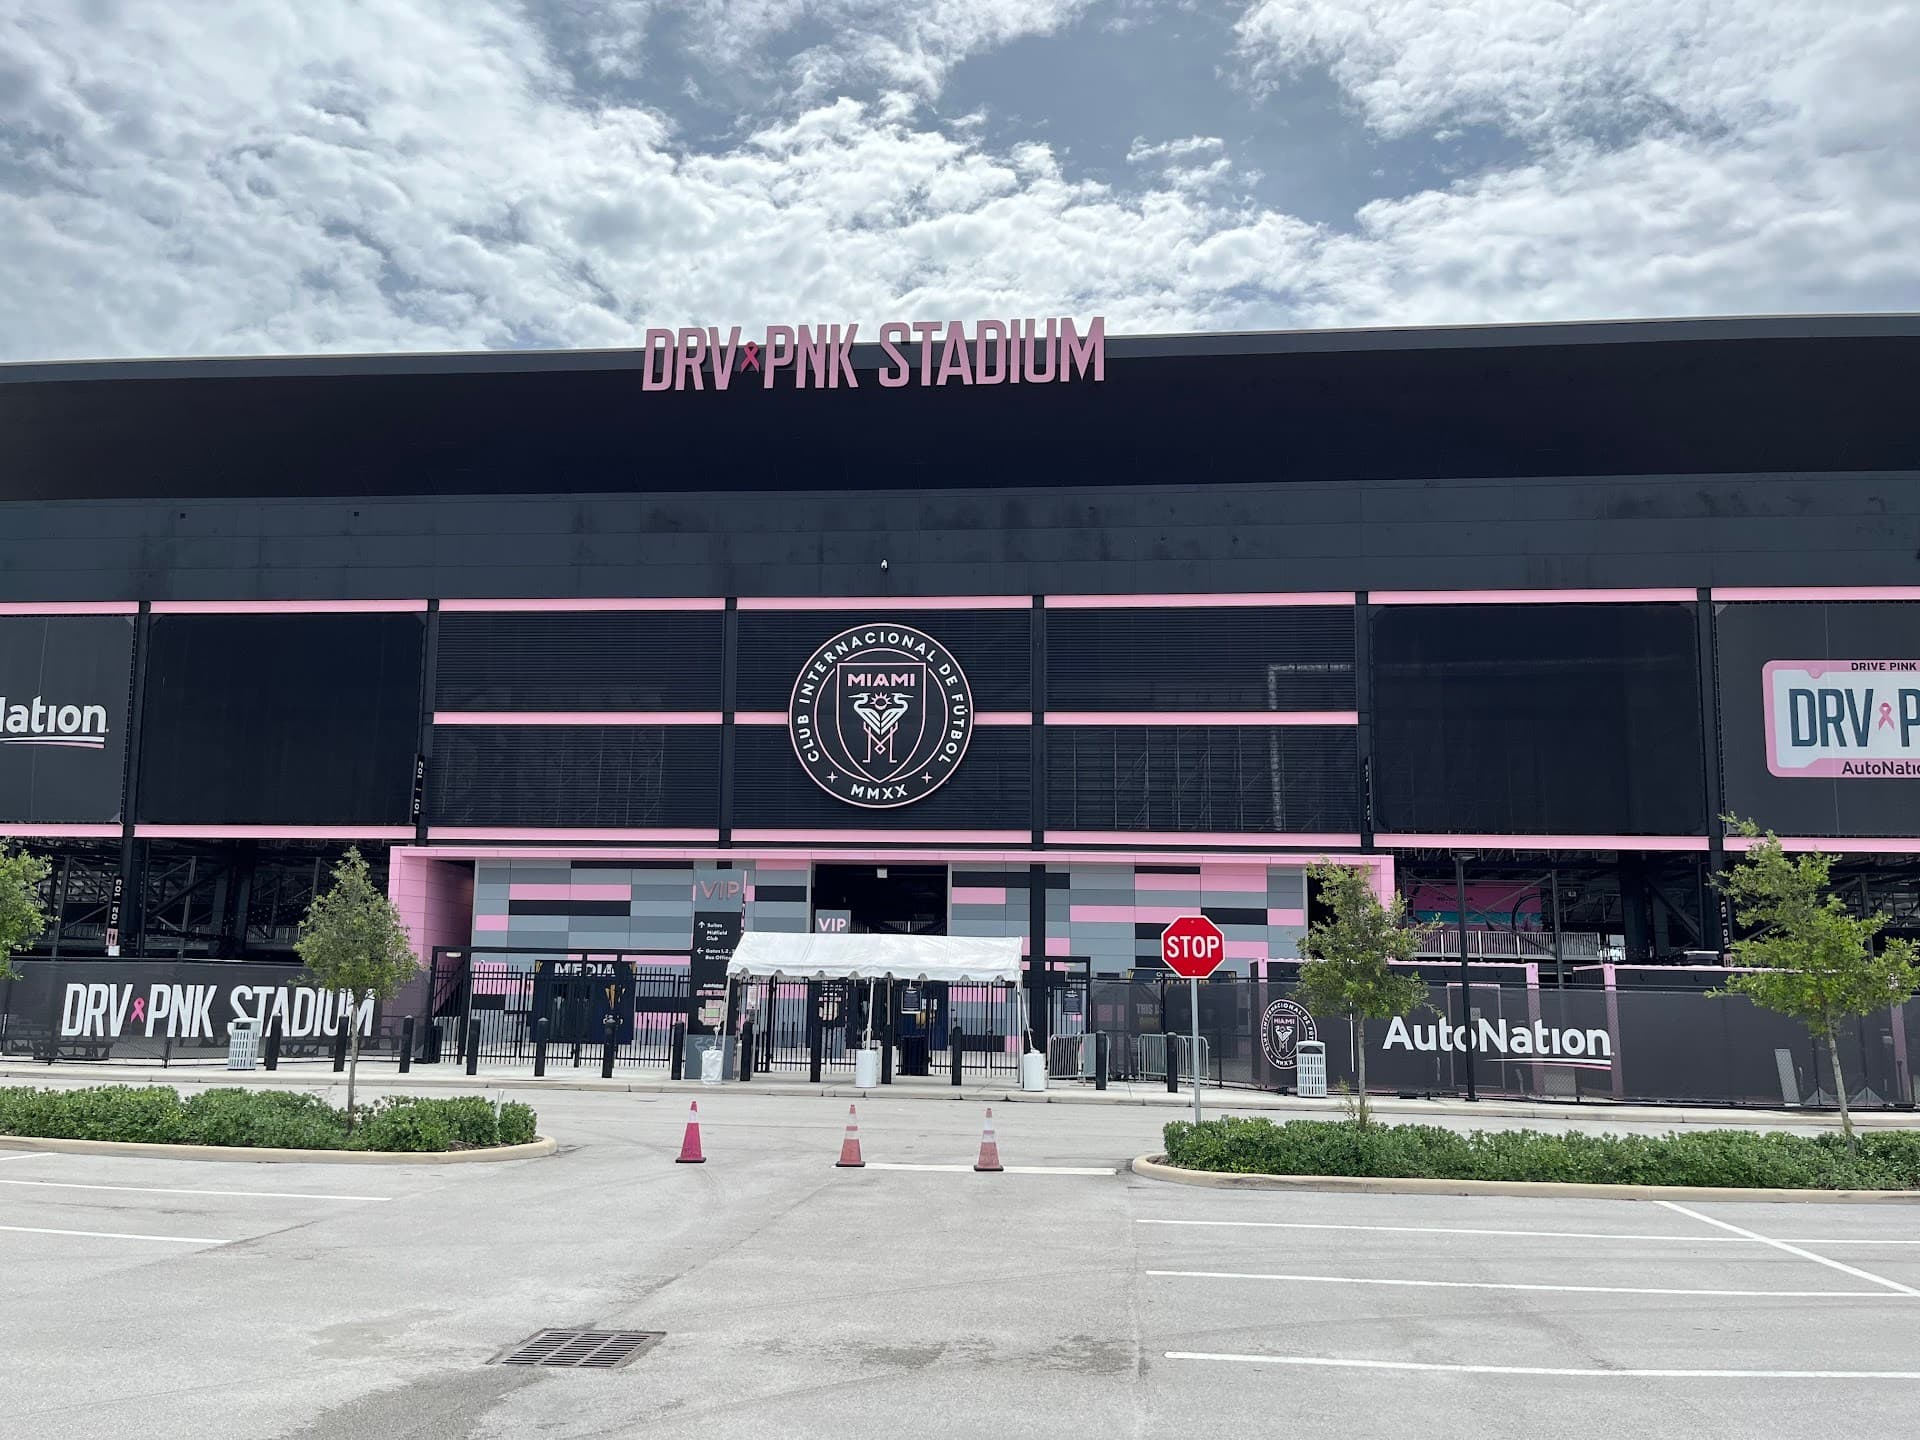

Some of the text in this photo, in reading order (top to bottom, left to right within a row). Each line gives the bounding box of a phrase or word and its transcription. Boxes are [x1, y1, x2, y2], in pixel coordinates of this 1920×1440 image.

[642, 317, 1105, 391] DRV PNK STADIUM
[1851, 662, 1917, 671] DRIVE PINK
[847, 673, 915, 687] MIAMI
[797, 631, 968, 763] CLUB INTERNACIONAL DE FÚTBOL
[1789, 688, 1874, 747] DRV
[850, 783, 908, 800] MMXX
[701, 880, 740, 899] VIP
[111, 906, 119, 925] 102
[818, 917, 847, 932] VIP
[1167, 935, 1220, 958] STOP
[554, 963, 616, 977] MEDIA
[61, 983, 133, 1037] DRV
[144, 984, 217, 1038] PNK
[1382, 1016, 1612, 1056] AutoNation
